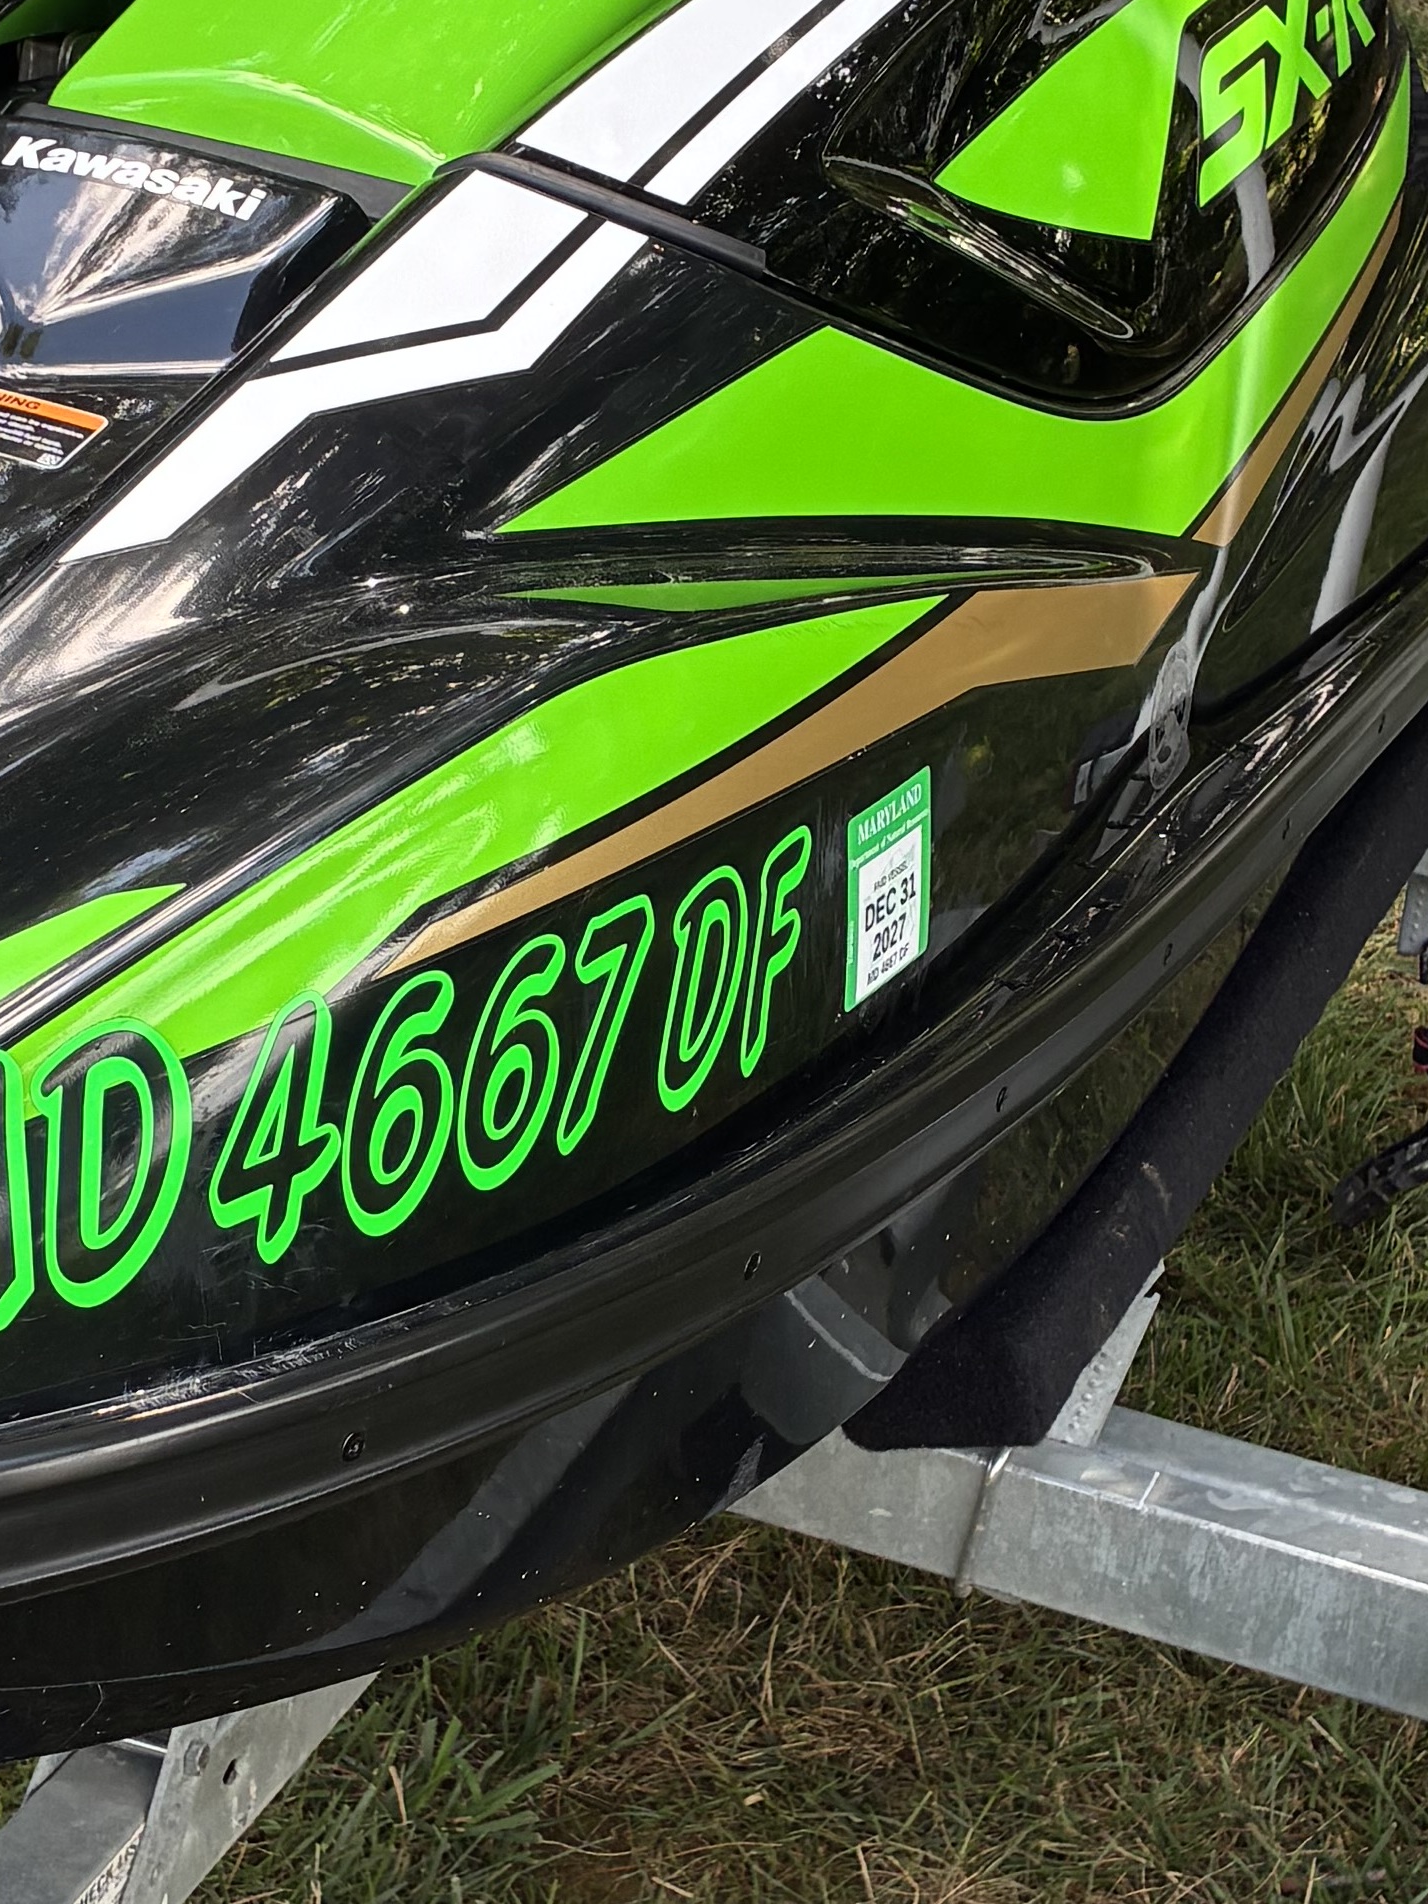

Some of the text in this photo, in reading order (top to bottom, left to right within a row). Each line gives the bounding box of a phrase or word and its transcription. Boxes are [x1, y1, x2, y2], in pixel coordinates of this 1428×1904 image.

[0, 134, 269, 222] Kawasaki
[857, 780, 922, 846] MARYLAND
[864, 883, 897, 933] DEC
[899, 868, 916, 907] 31
[871, 910, 907, 963] 2027
[208, 892, 656, 1266] 4667
[656, 824, 813, 1113] DF
